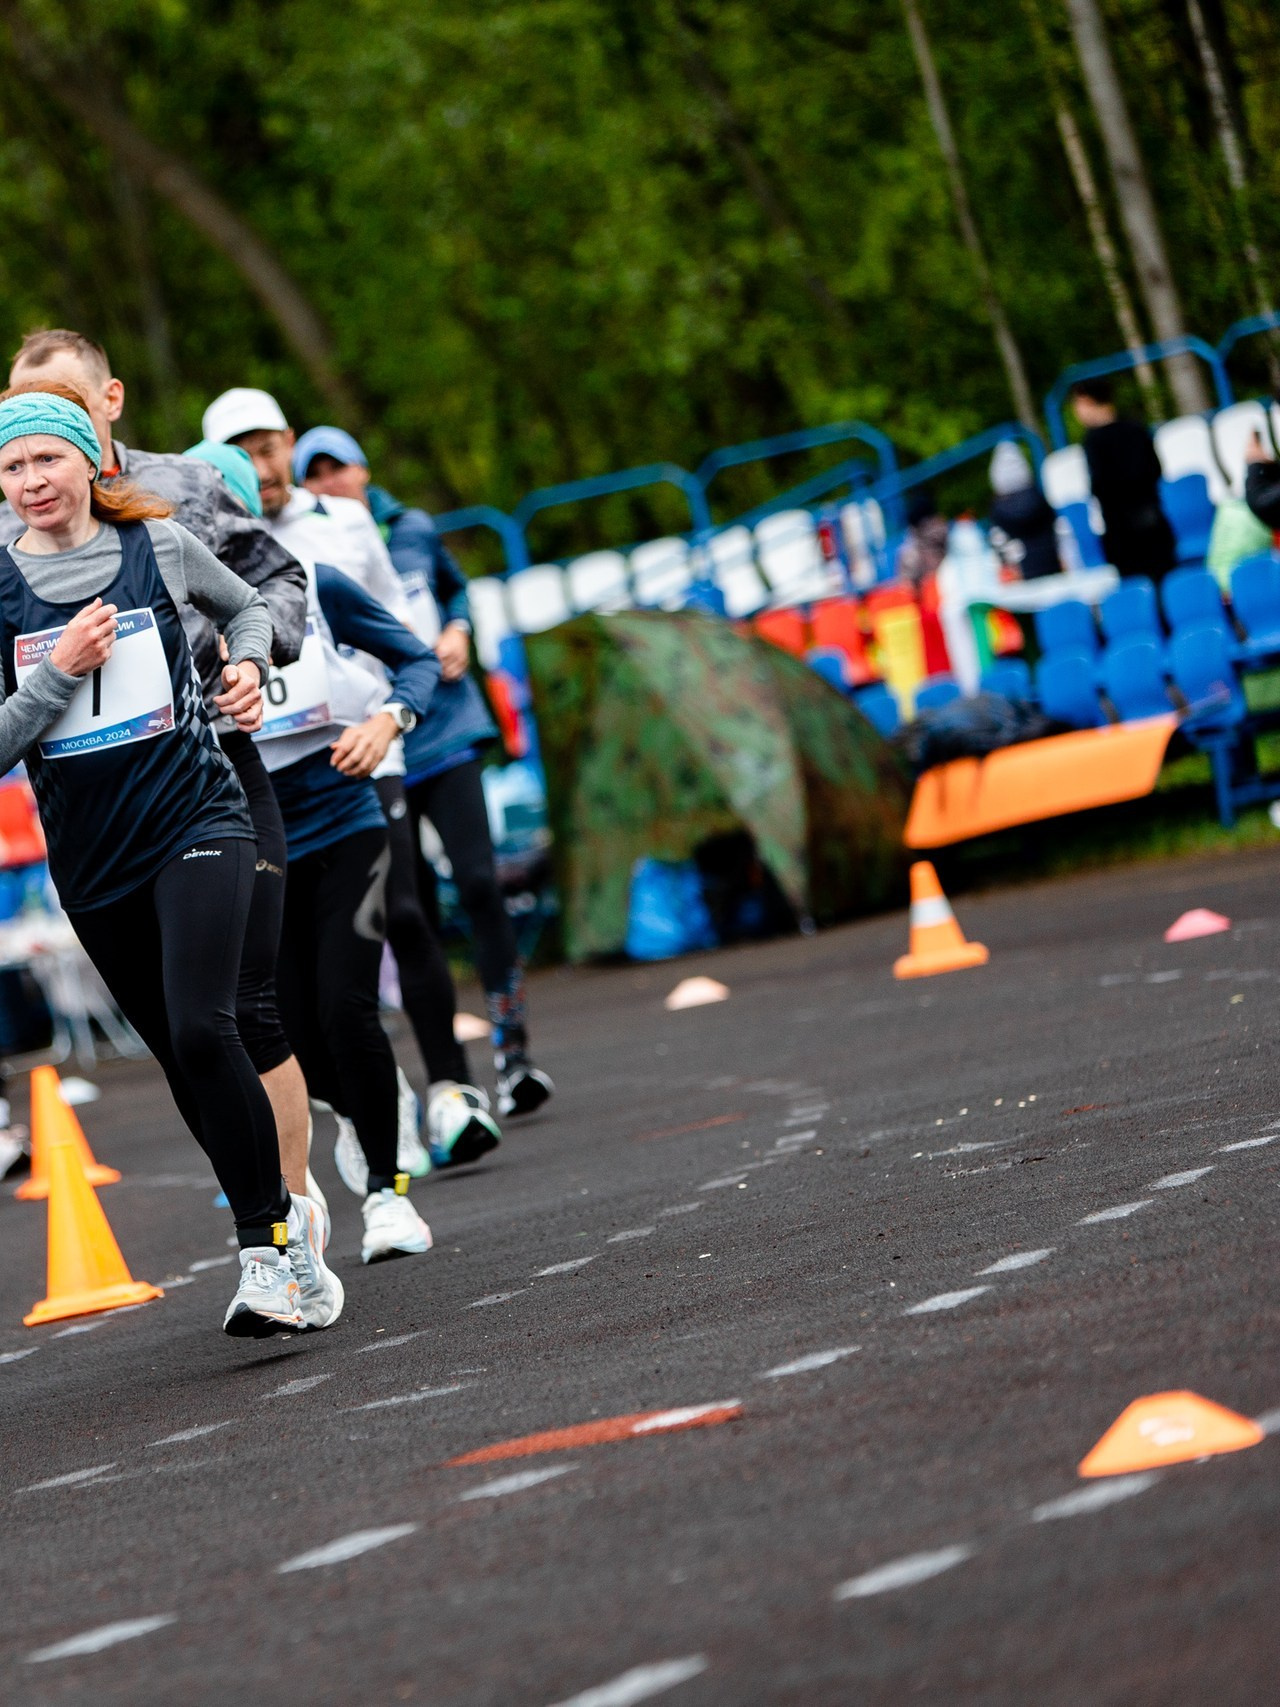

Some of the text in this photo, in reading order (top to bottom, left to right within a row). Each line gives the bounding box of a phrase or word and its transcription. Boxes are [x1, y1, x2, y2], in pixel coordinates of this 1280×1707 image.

[61, 728, 132, 750] МОСКВА 2024
[182, 848, 223, 860] DEMIX
